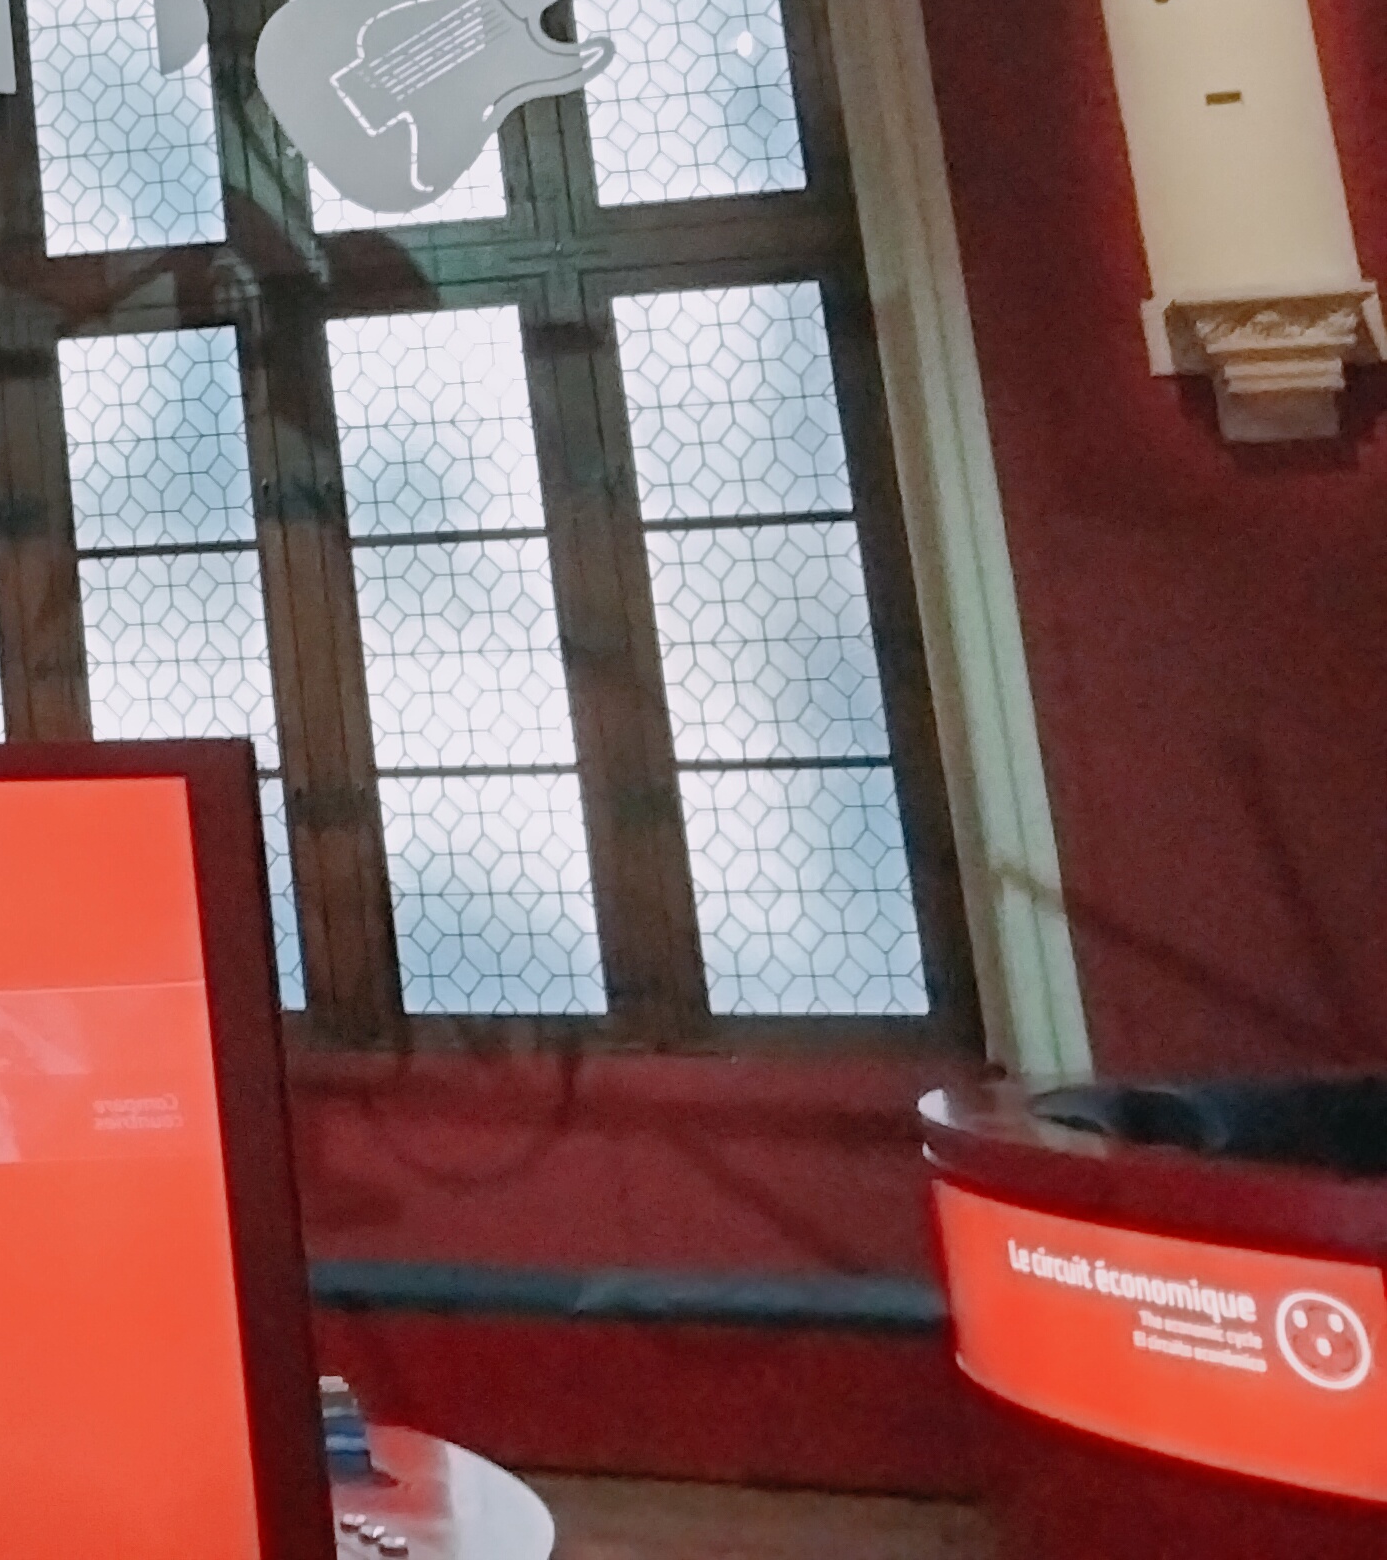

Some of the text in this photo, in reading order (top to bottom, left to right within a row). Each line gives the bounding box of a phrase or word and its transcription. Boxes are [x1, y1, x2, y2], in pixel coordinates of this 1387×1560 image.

[1008, 1239, 1258, 1324] Le circuit économique
